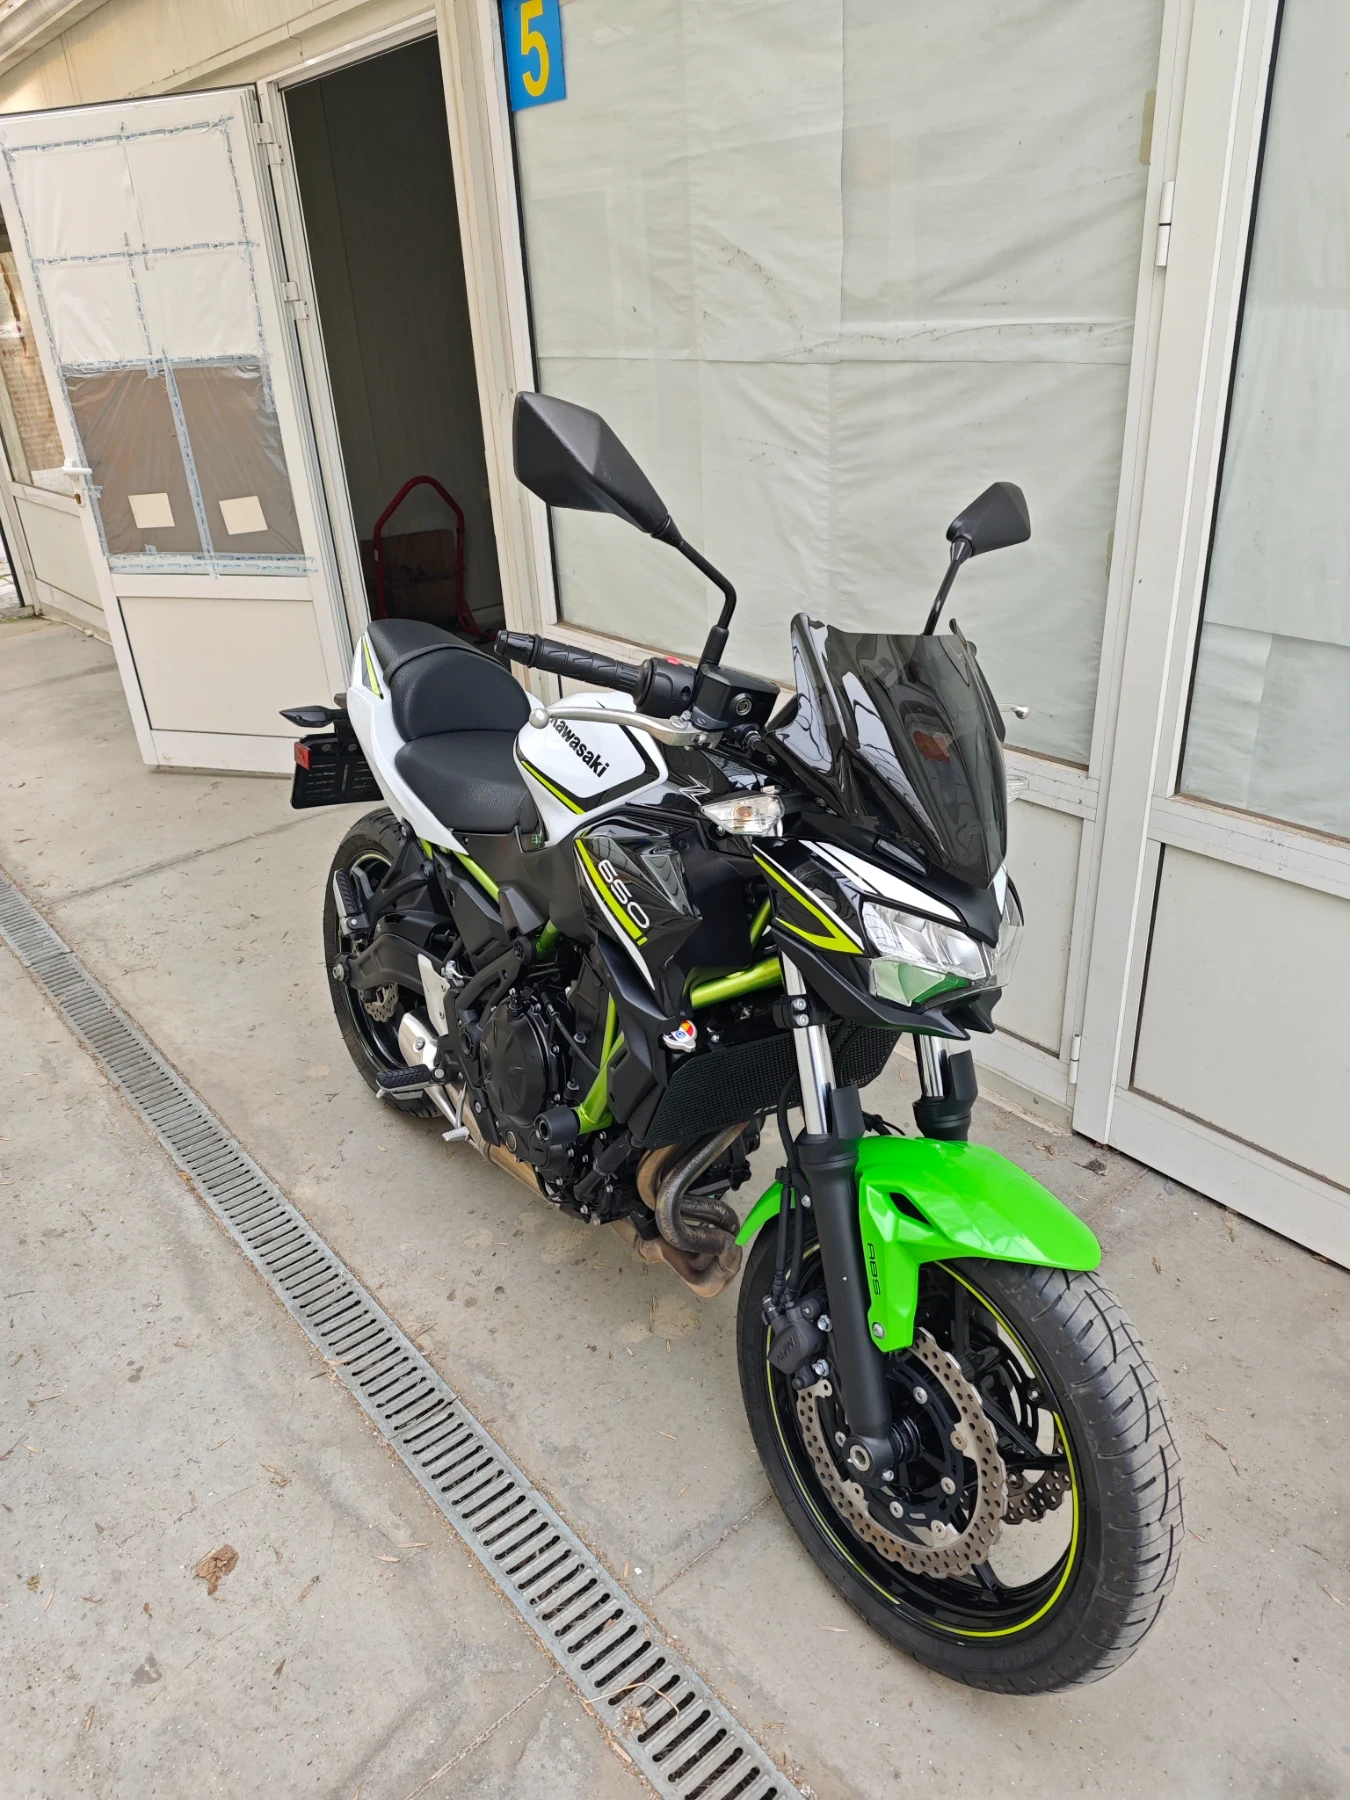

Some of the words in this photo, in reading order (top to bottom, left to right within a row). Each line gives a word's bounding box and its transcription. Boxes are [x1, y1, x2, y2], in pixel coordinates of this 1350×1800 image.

[521, 0, 550, 97] 5
[598, 859, 650, 929] 650
[867, 1242, 881, 1296] ABS
